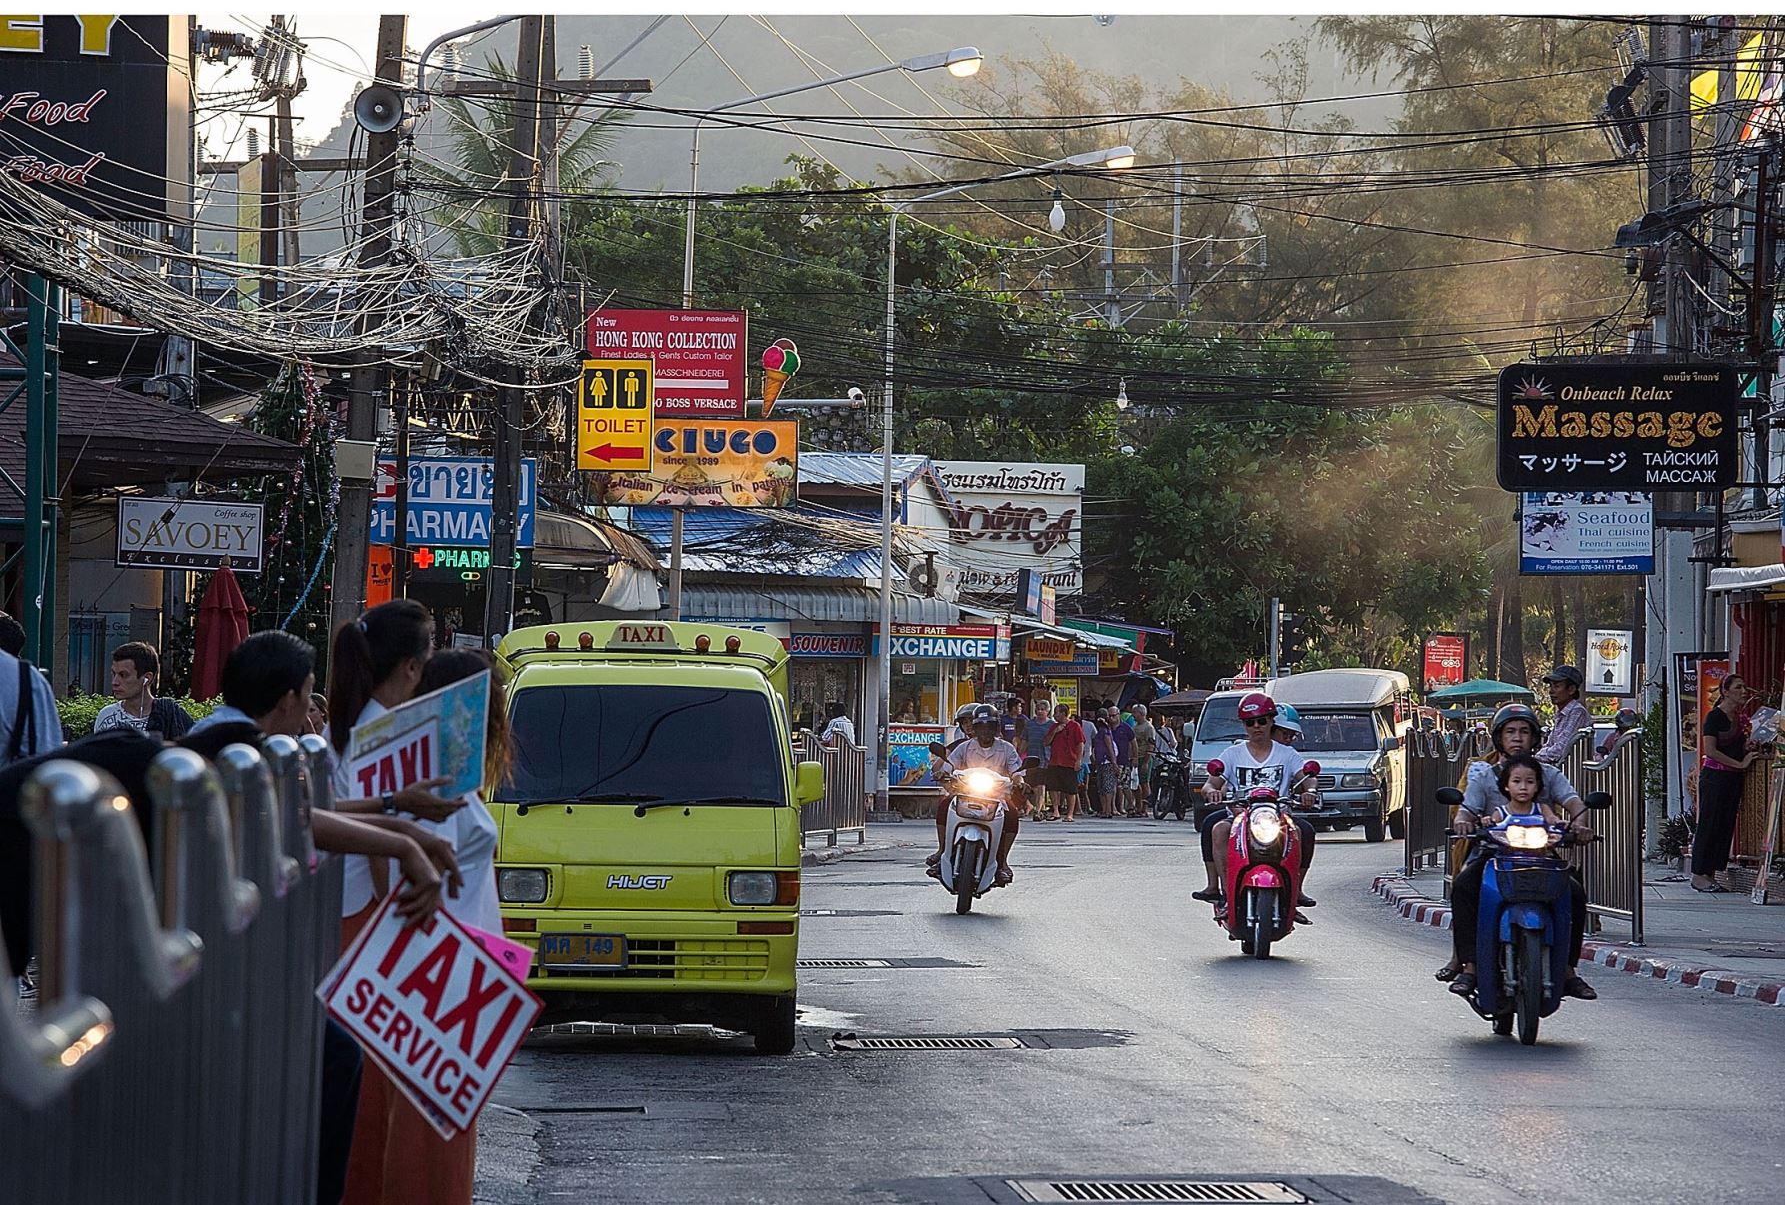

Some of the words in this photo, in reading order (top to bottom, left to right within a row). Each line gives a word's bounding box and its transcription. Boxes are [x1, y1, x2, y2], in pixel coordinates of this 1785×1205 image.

[1, 89, 107, 126] Food
[596, 316, 617, 327] New
[596, 330, 627, 348] HONG
[632, 331, 664, 349] KONG
[667, 332, 737, 350] COLLECTION
[600, 350, 621, 359] Finest
[624, 350, 647, 359] Ladies
[658, 351, 681, 360] Gents
[683, 351, 711, 360] Custom
[714, 352, 733, 361] Tailor
[1560, 385, 1625, 400] Onbeach
[1630, 386, 1674, 400] Relax
[666, 397, 690, 408] BOSS
[694, 398, 737, 409] VERSACE
[584, 419, 647, 433] TOILET
[1512, 404, 1723, 448] Massage
[663, 456, 688, 465] since
[697, 457, 720, 466] 1989
[1518, 451, 1627, 474] マッサージ
[1643, 450, 1719, 466] ТАЙСКИЙ
[1646, 470, 1716, 483] МАССАЖ
[618, 476, 653, 492] Italian
[732, 482, 742, 492] in
[214, 509, 238, 519] Coffee
[239, 510, 256, 520] shop
[1577, 511, 1650, 525] Seafood
[125, 518, 256, 551] SAVOEY
[1580, 528, 1602, 537] Thai
[1608, 528, 1650, 537] cuisine
[1580, 540, 1612, 548] French
[1616, 540, 1650, 548] cuisine
[618, 626, 665, 643] TAXI
[900, 626, 922, 634] BEST
[924, 627, 947, 635] RATE
[791, 635, 865, 655] SOUVENIR
[890, 637, 989, 657] XCHANGE
[1028, 641, 1072, 655] LAUNDRY
[1591, 642, 1610, 650] Hard
[1610, 643, 1628, 652] Rock
[889, 733, 941, 744] EXCHANGE
[606, 874, 673, 889] HIJET
[378, 920, 525, 1071] TAXI
[347, 978, 481, 1116] SERVICE
